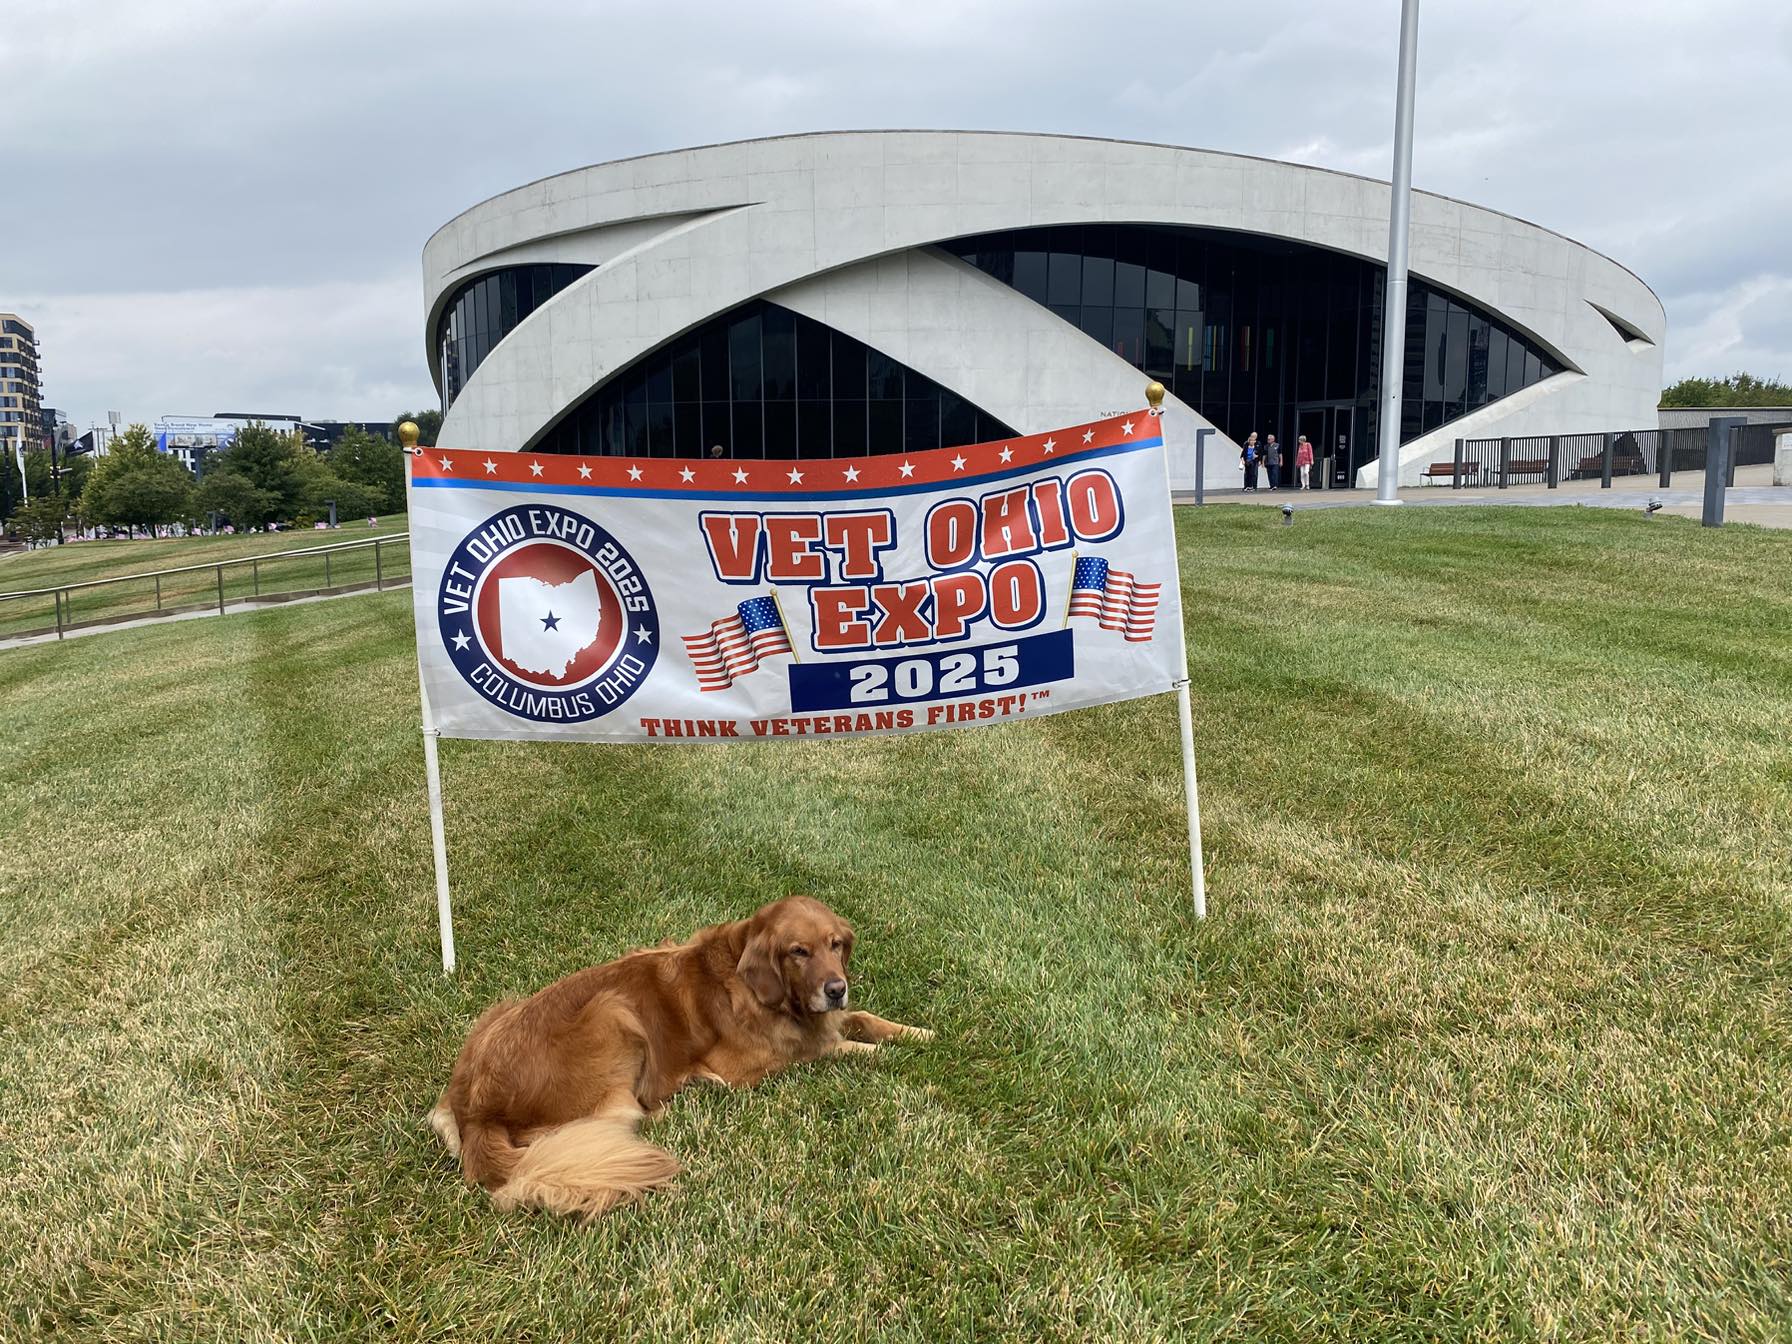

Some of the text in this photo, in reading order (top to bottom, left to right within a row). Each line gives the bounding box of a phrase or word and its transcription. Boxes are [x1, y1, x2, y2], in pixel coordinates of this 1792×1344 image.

[444, 510, 650, 615] VET OHIO EXPO 2025
[699, 468, 1124, 585] VET OHIO
[808, 558, 1044, 653] EXPO
[470, 653, 646, 719] COLUMBUS OHIO
[849, 646, 1020, 703] 2025
[640, 718, 739, 737] THINK
[750, 709, 914, 736] VETERANS
